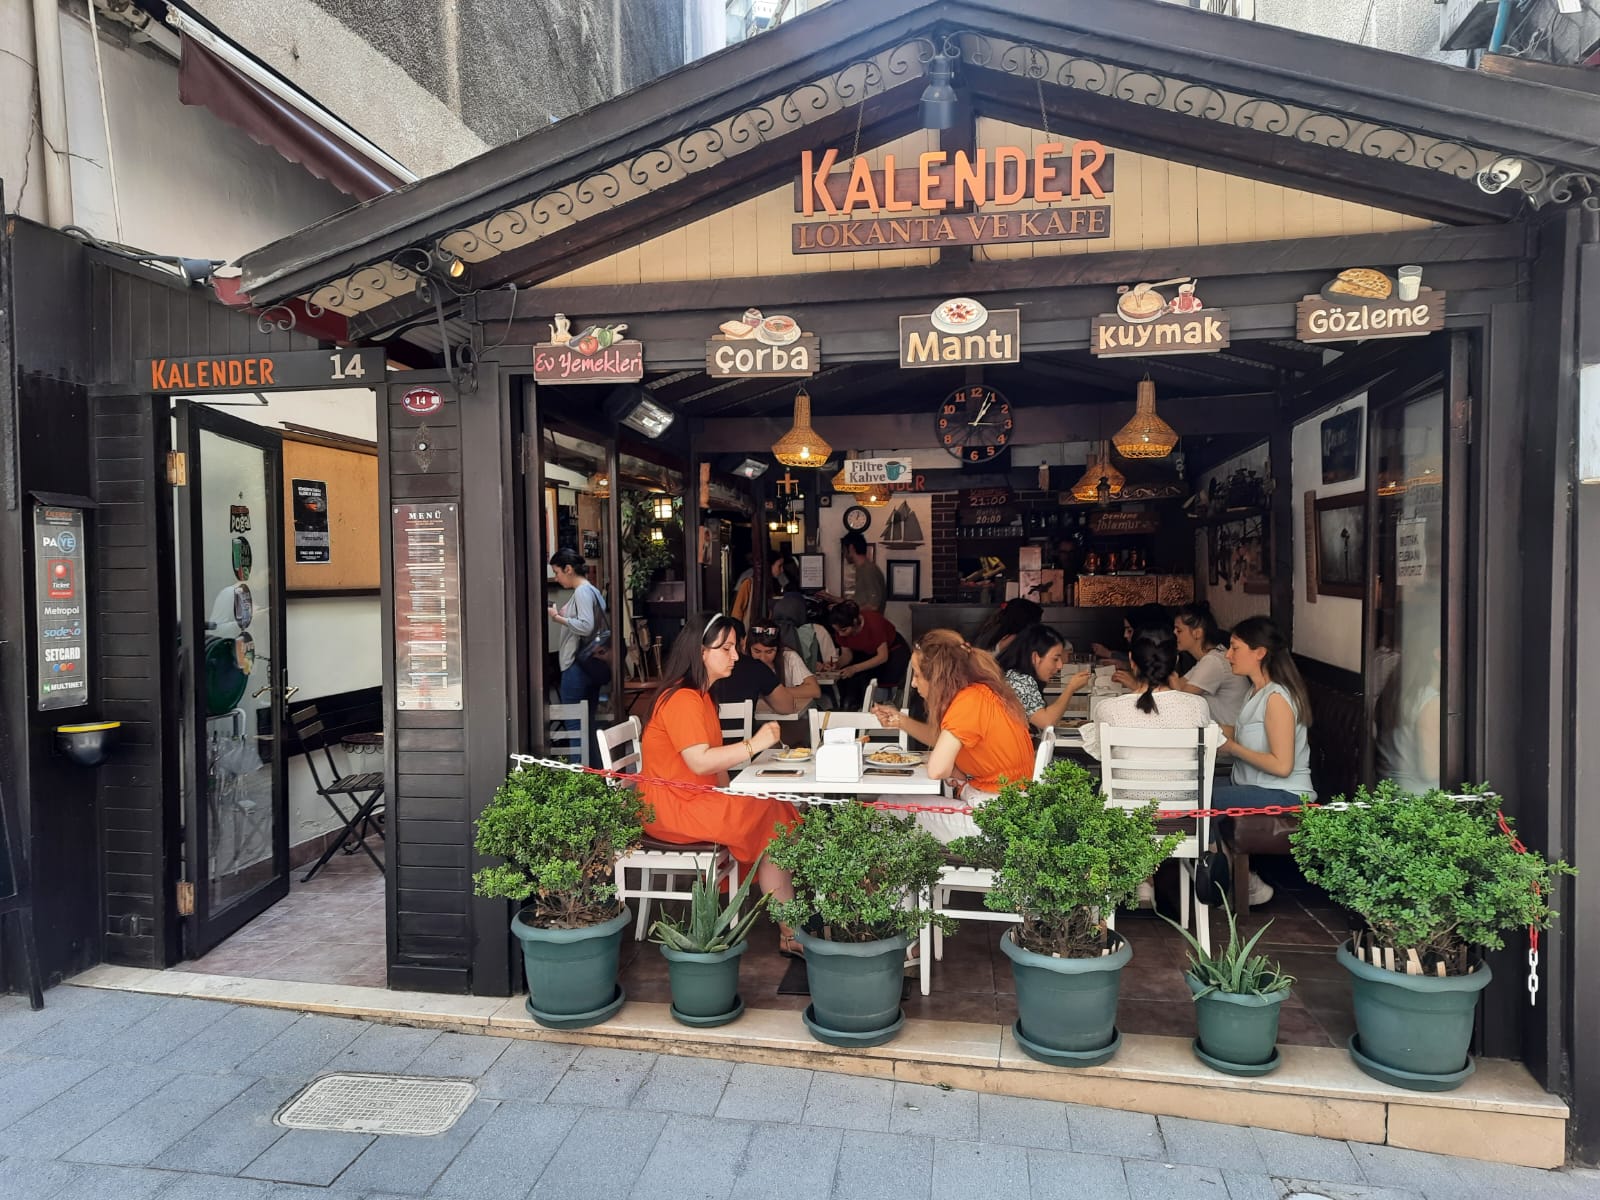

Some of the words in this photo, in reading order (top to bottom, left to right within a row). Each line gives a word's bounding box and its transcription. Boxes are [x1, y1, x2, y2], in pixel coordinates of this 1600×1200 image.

[801, 140, 1106, 217] KALENDER
[799, 218, 957, 249] LOKANTA
[966, 213, 1009, 240] VE
[1017, 209, 1106, 237] KAFE
[1308, 304, 1430, 334] Gözleme
[906, 329, 1012, 363] Mantı
[535, 352, 554, 372] Ev
[559, 350, 643, 378] Yemekleri
[715, 345, 809, 374] Çorba
[329, 353, 366, 380] 14
[151, 358, 275, 390] KALENDER
[955, 392, 966, 402] 11
[970, 387, 983, 397] 12
[991, 392, 996, 402] 1
[416, 395, 426, 405] 14
[943, 404, 956, 414] 10
[1001, 404, 1009, 414] 2
[939, 418, 948, 428] 9
[1004, 419, 1012, 429] 3
[944, 434, 952, 444] 8
[997, 434, 1006, 444] 4
[955, 445, 963, 455] 7
[970, 450, 979, 460] 6
[986, 446, 995, 456] 5
[851, 461, 883, 472] Filtre
[849, 472, 886, 483] Kahve
[408, 510, 442, 520] MENÜ
[44, 605, 80, 616] Metropol
[44, 625, 81, 638] sodexo
[45, 646, 81, 662] SETCARD
[50, 681, 84, 691] MULTINET
